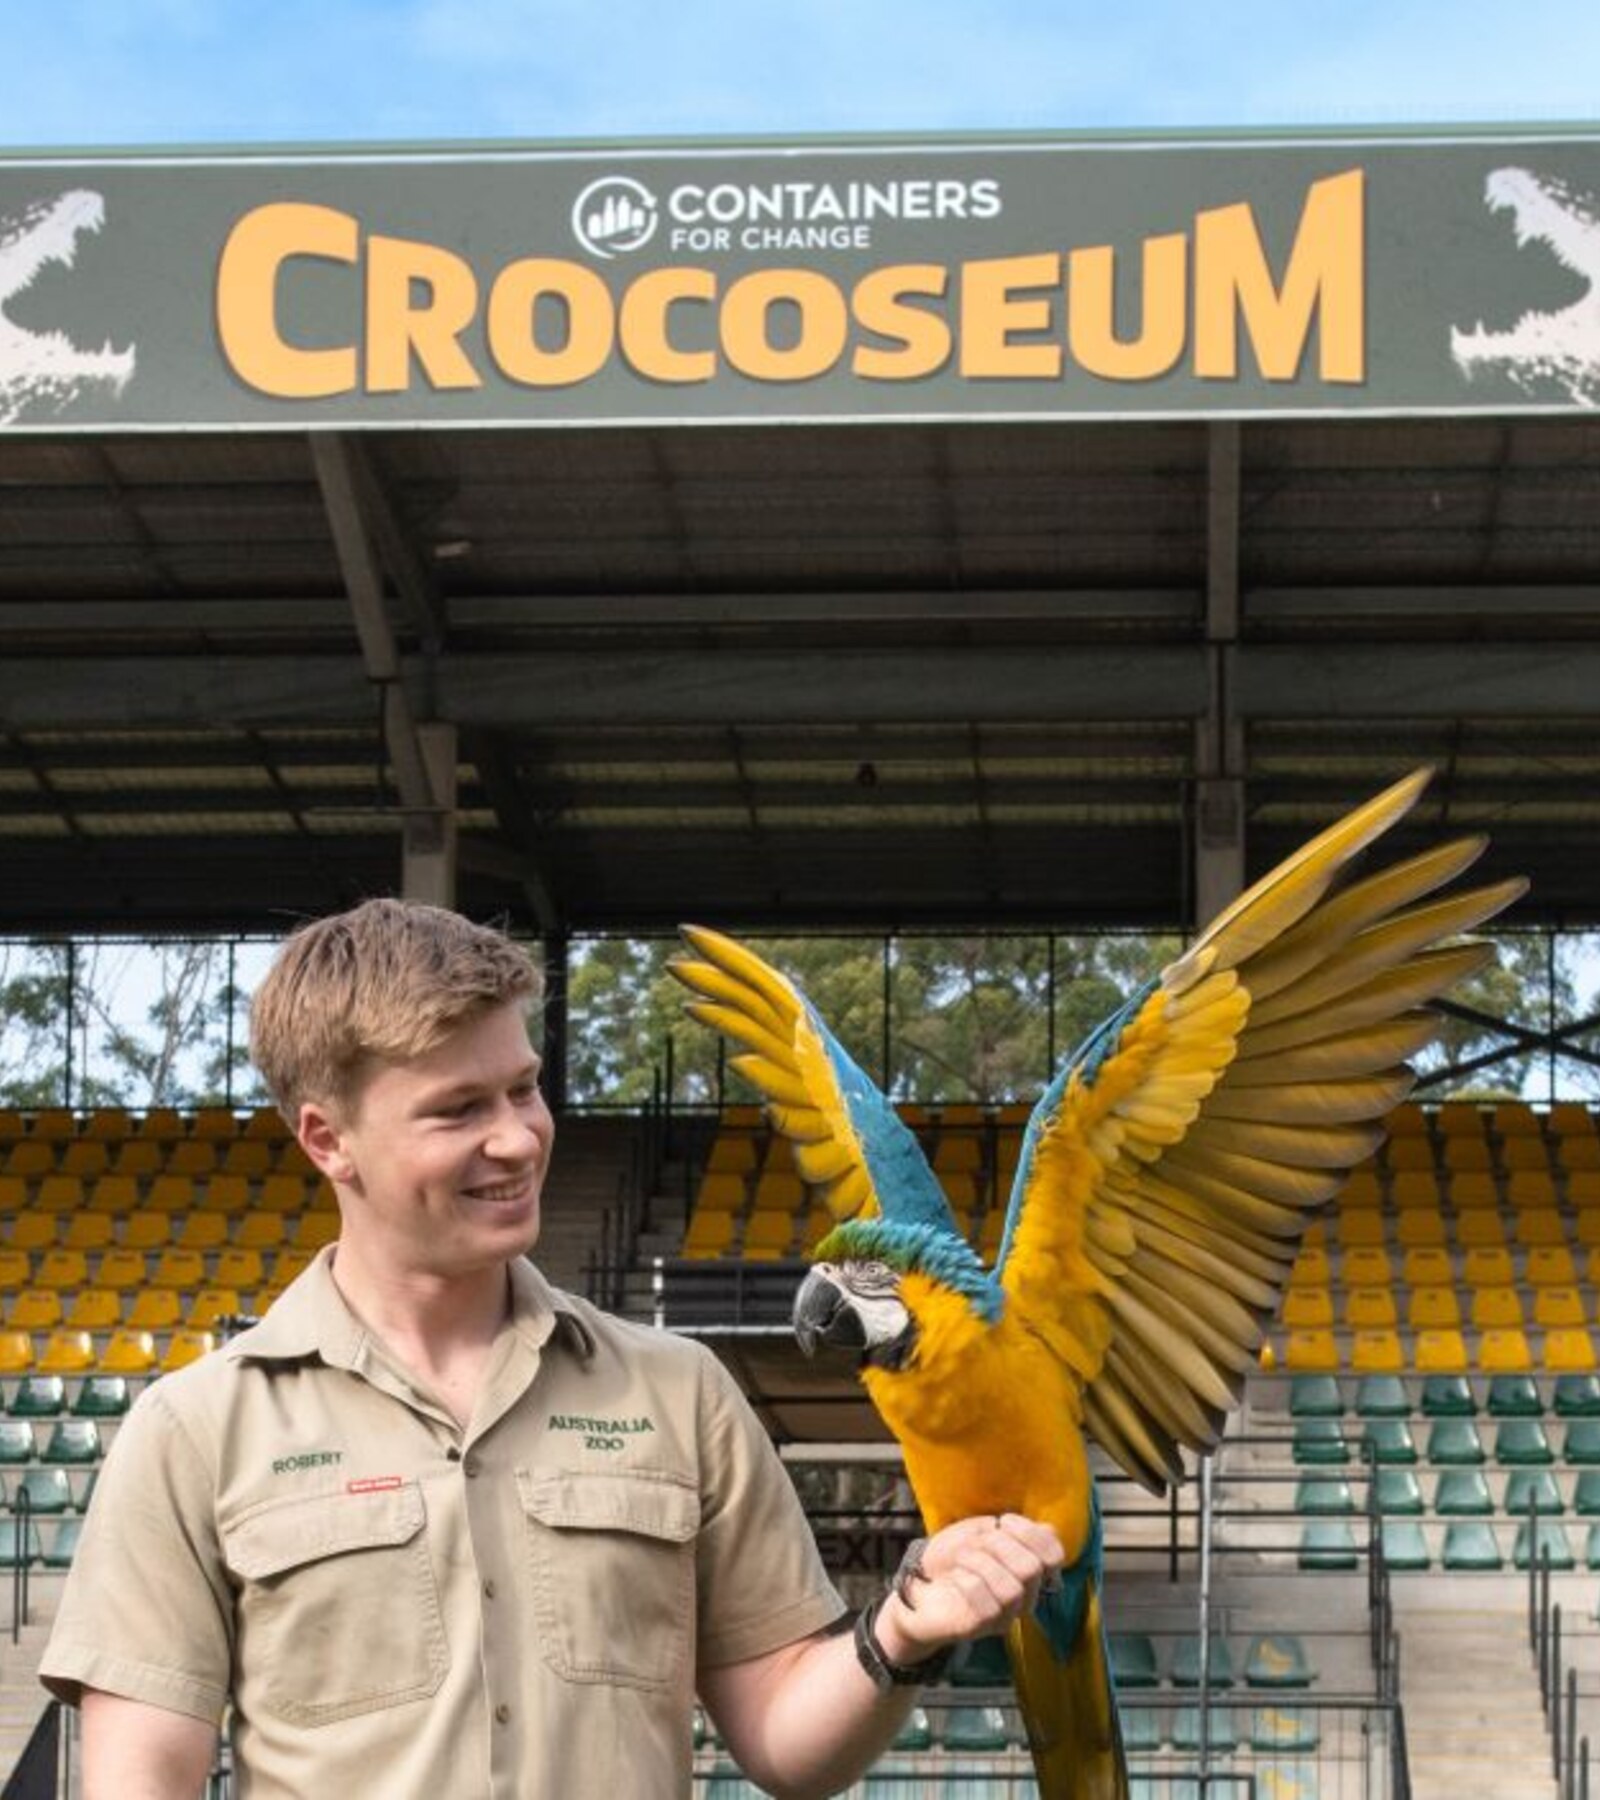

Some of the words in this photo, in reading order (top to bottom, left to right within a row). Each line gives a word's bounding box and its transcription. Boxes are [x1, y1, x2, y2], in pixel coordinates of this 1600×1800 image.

[668, 180, 1001, 222] CONTAINERS
[671, 227, 731, 251] FOR
[741, 225, 871, 249] CHANGE
[216, 167, 1365, 399] CROCOSEUM
[548, 1415, 655, 1434] AUSTRALIA
[585, 1436, 625, 1450] ZOO
[272, 1451, 343, 1474] ROBERT
